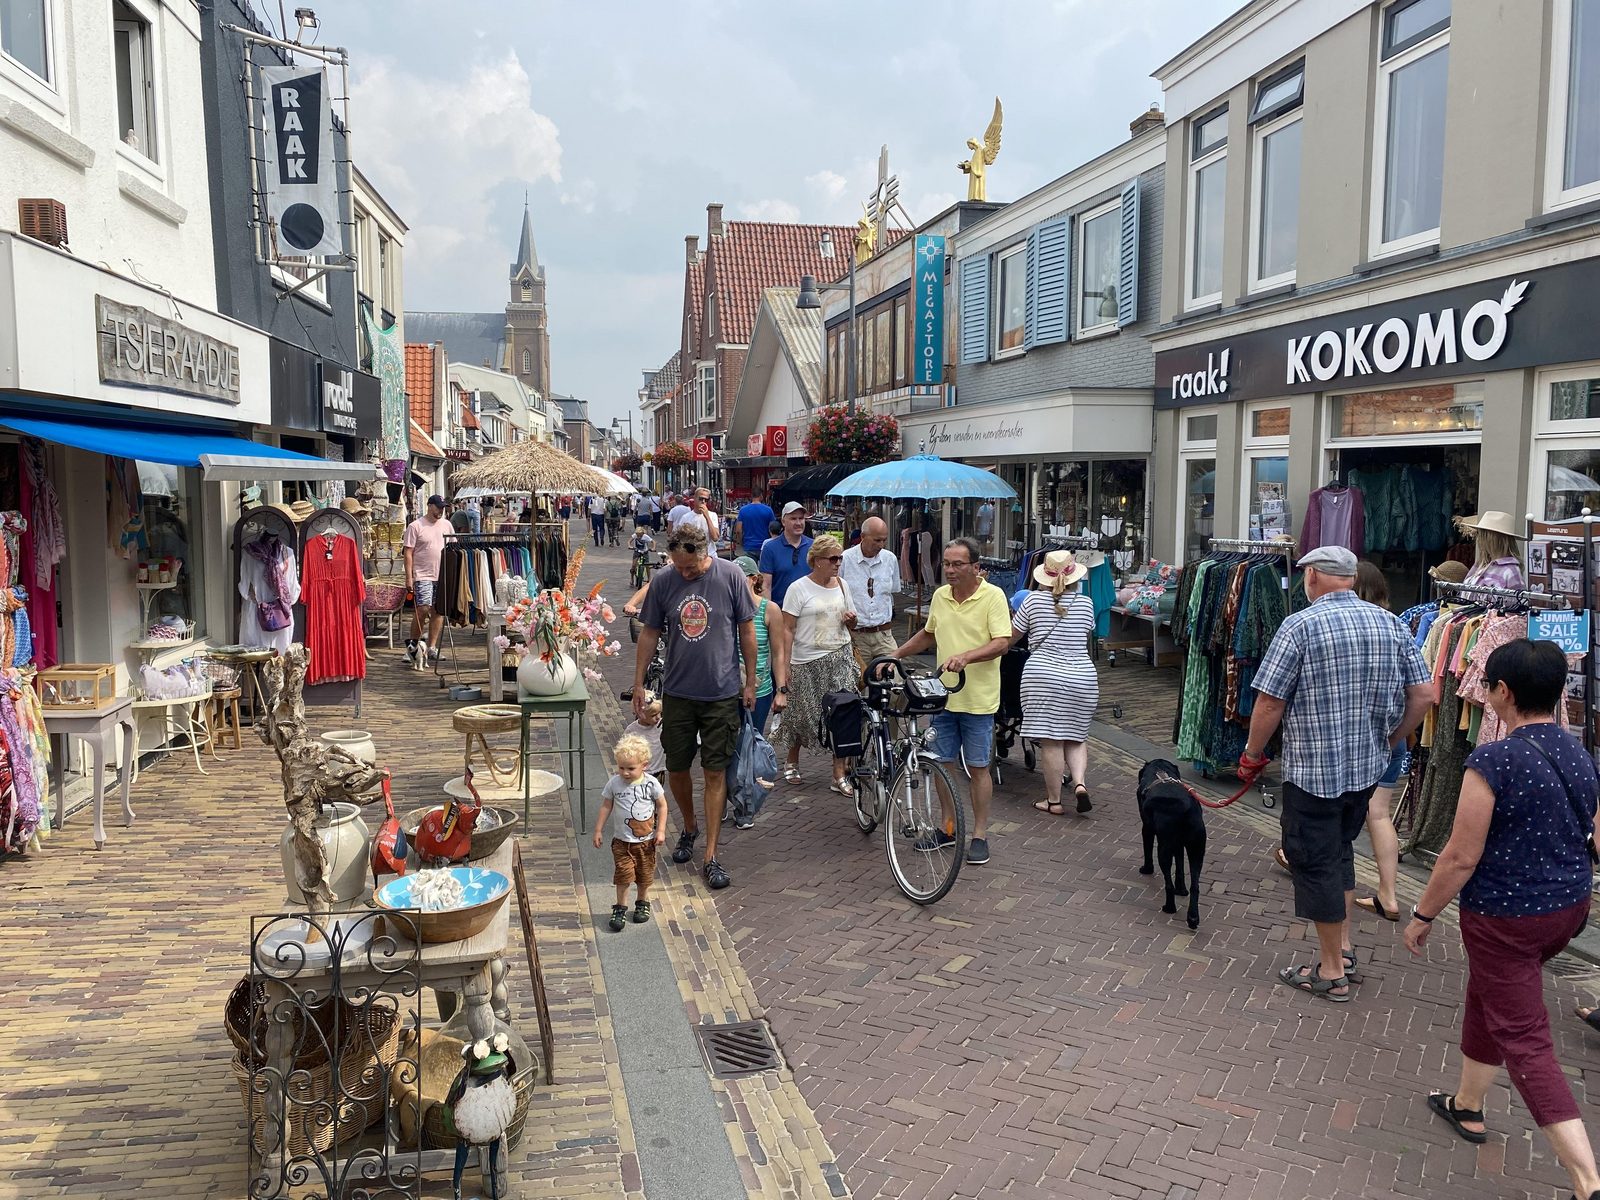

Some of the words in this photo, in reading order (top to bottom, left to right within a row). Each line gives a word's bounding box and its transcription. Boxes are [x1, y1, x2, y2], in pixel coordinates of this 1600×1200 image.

[279, 87, 308, 178] RAAK
[922, 271, 938, 382] MEGASTORE
[1286, 296, 1510, 385] KOKOMO
[1171, 347, 1230, 399] raak!
[447, 450, 467, 459] Wijn
[1535, 613, 1582, 623] SUMMER
[1539, 623, 1579, 637] SALE
